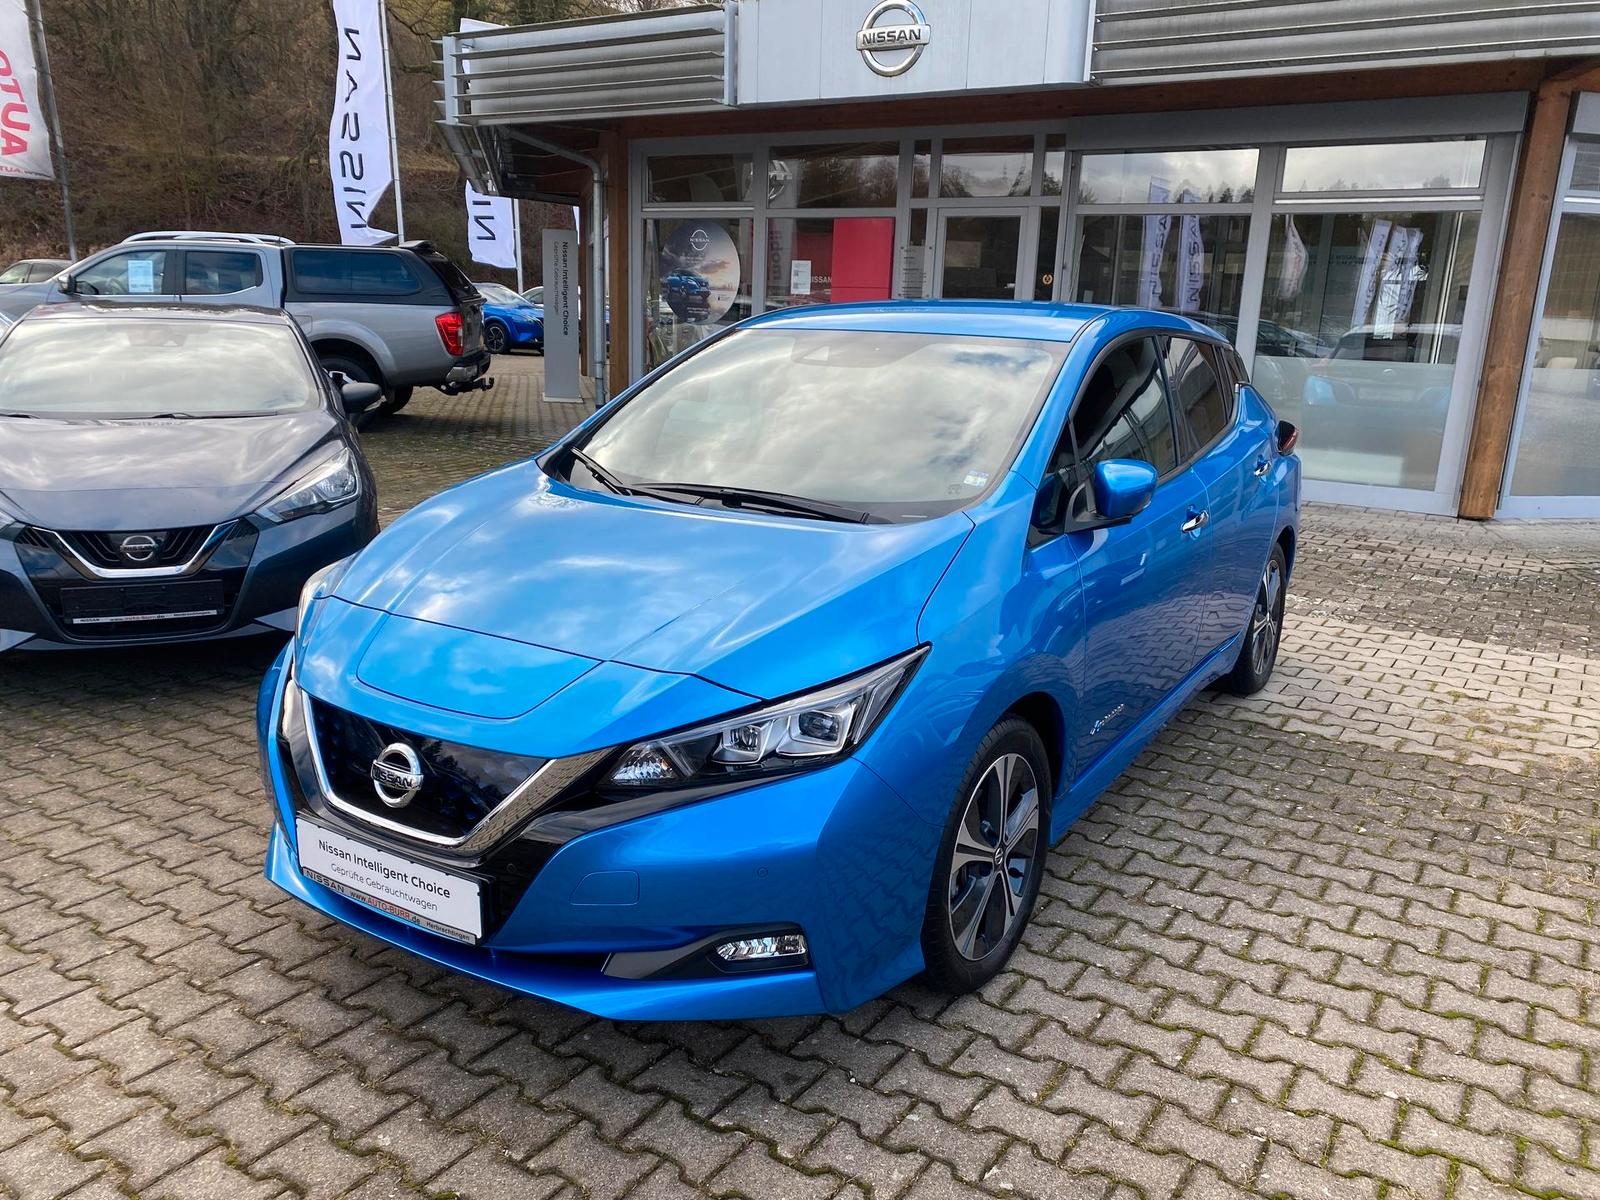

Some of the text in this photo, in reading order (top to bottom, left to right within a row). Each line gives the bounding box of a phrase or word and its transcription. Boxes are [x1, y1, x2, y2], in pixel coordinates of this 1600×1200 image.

[862, 29, 921, 44] NISSAN
[561, 269, 569, 308] Intelligent
[811, 275, 832, 283] ISSAN
[373, 765, 414, 789] NISSAN
[318, 839, 451, 898] Nissan Intelligent Choice
[306, 870, 345, 893] NISSAN
[331, 863, 438, 911] Geprüfte Gebrauchtwagen
